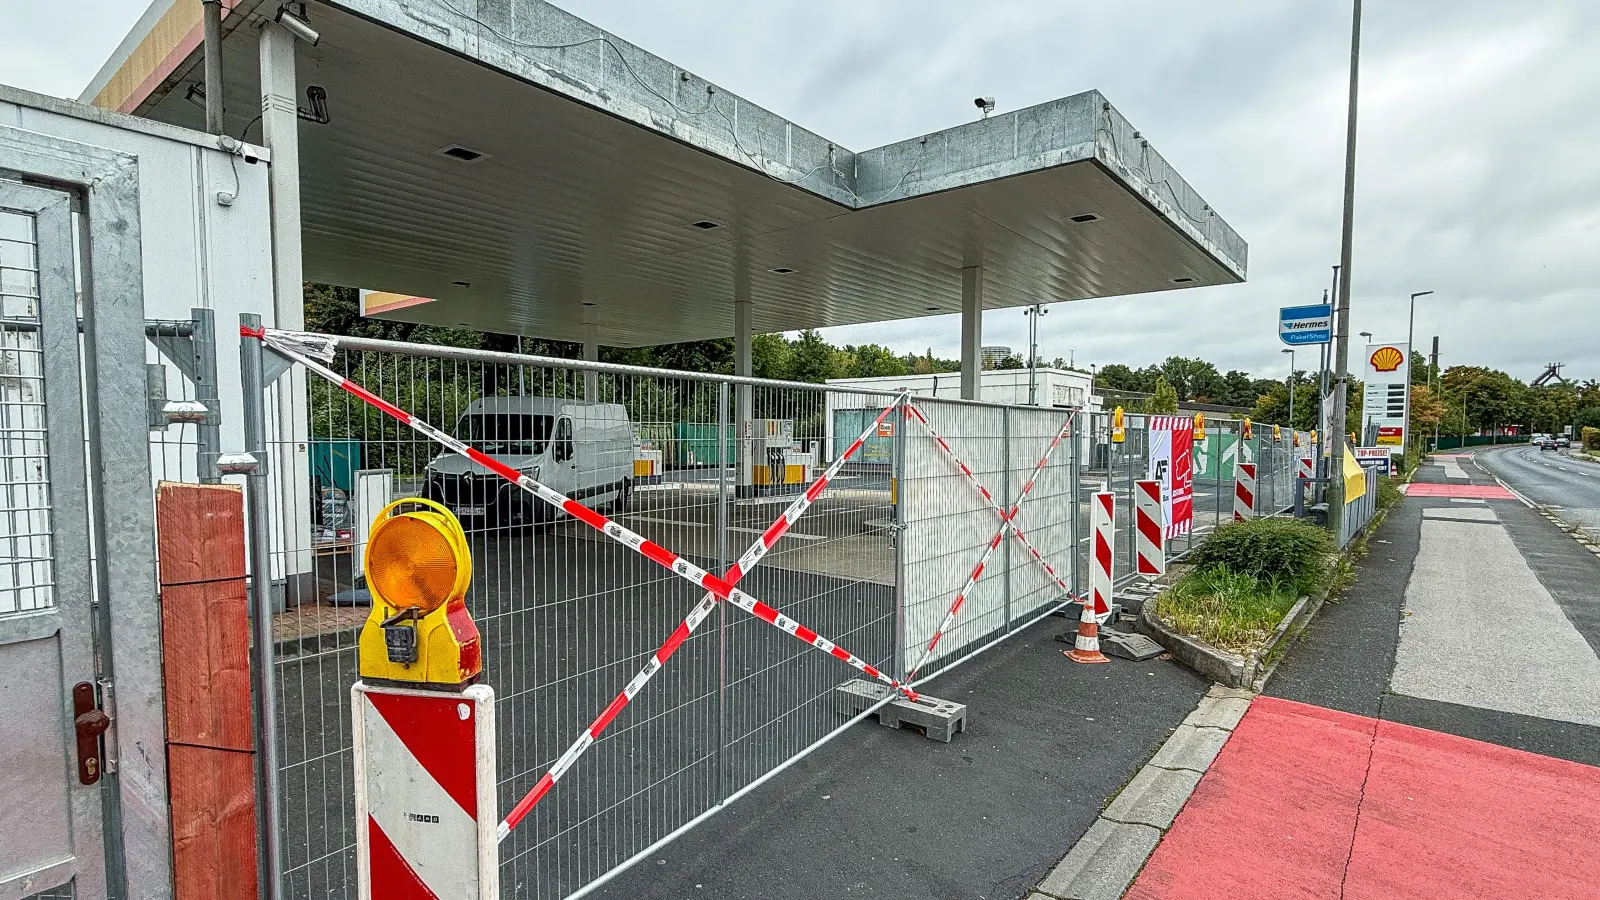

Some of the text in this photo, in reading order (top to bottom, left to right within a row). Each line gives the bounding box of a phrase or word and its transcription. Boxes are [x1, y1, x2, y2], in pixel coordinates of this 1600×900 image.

[1293, 321, 1328, 329] Hermes
[1290, 333, 1327, 341] PaketShop
[1357, 449, 1388, 457] TOP-PREISE!
